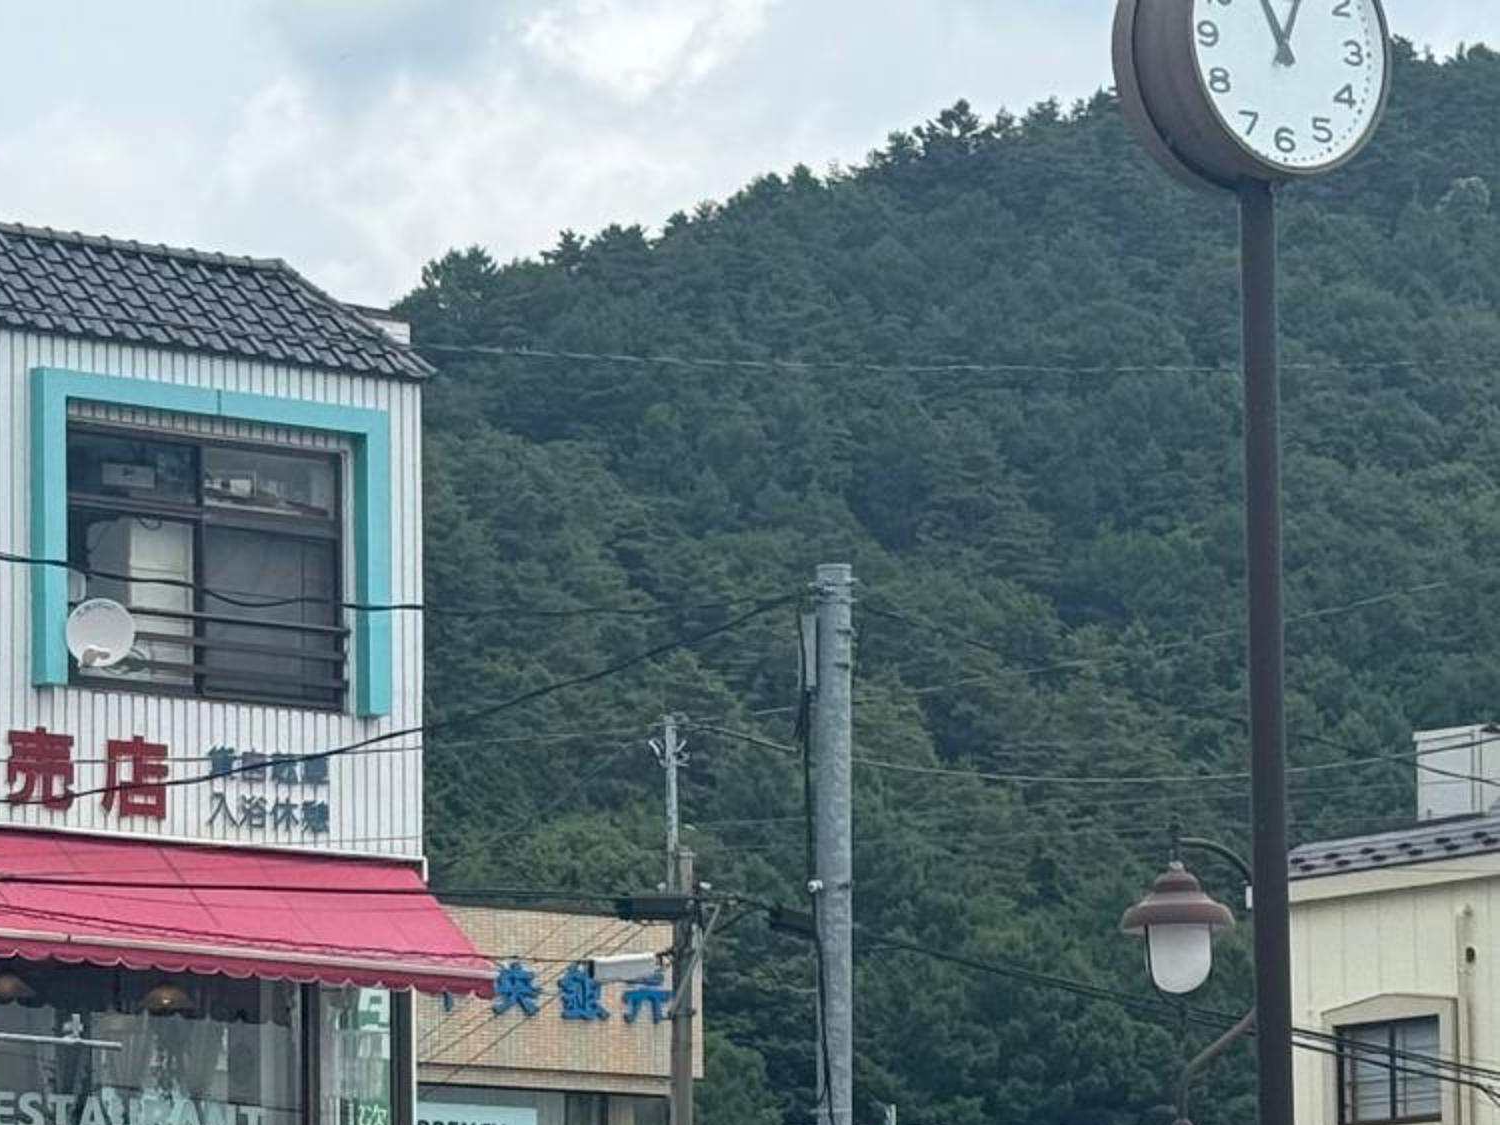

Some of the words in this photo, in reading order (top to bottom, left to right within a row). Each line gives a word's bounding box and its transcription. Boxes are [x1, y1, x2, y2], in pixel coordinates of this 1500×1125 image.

[1197, 20, 1219, 47] 9
[1343, 40, 1363, 66] 3
[1209, 67, 1231, 93] 8
[1332, 83, 1357, 109] 4
[1238, 110, 1259, 136] 7
[1312, 116, 1333, 143] 5
[1274, 126, 1296, 153] 6
[206, 792, 330, 833] 入浴休憩
